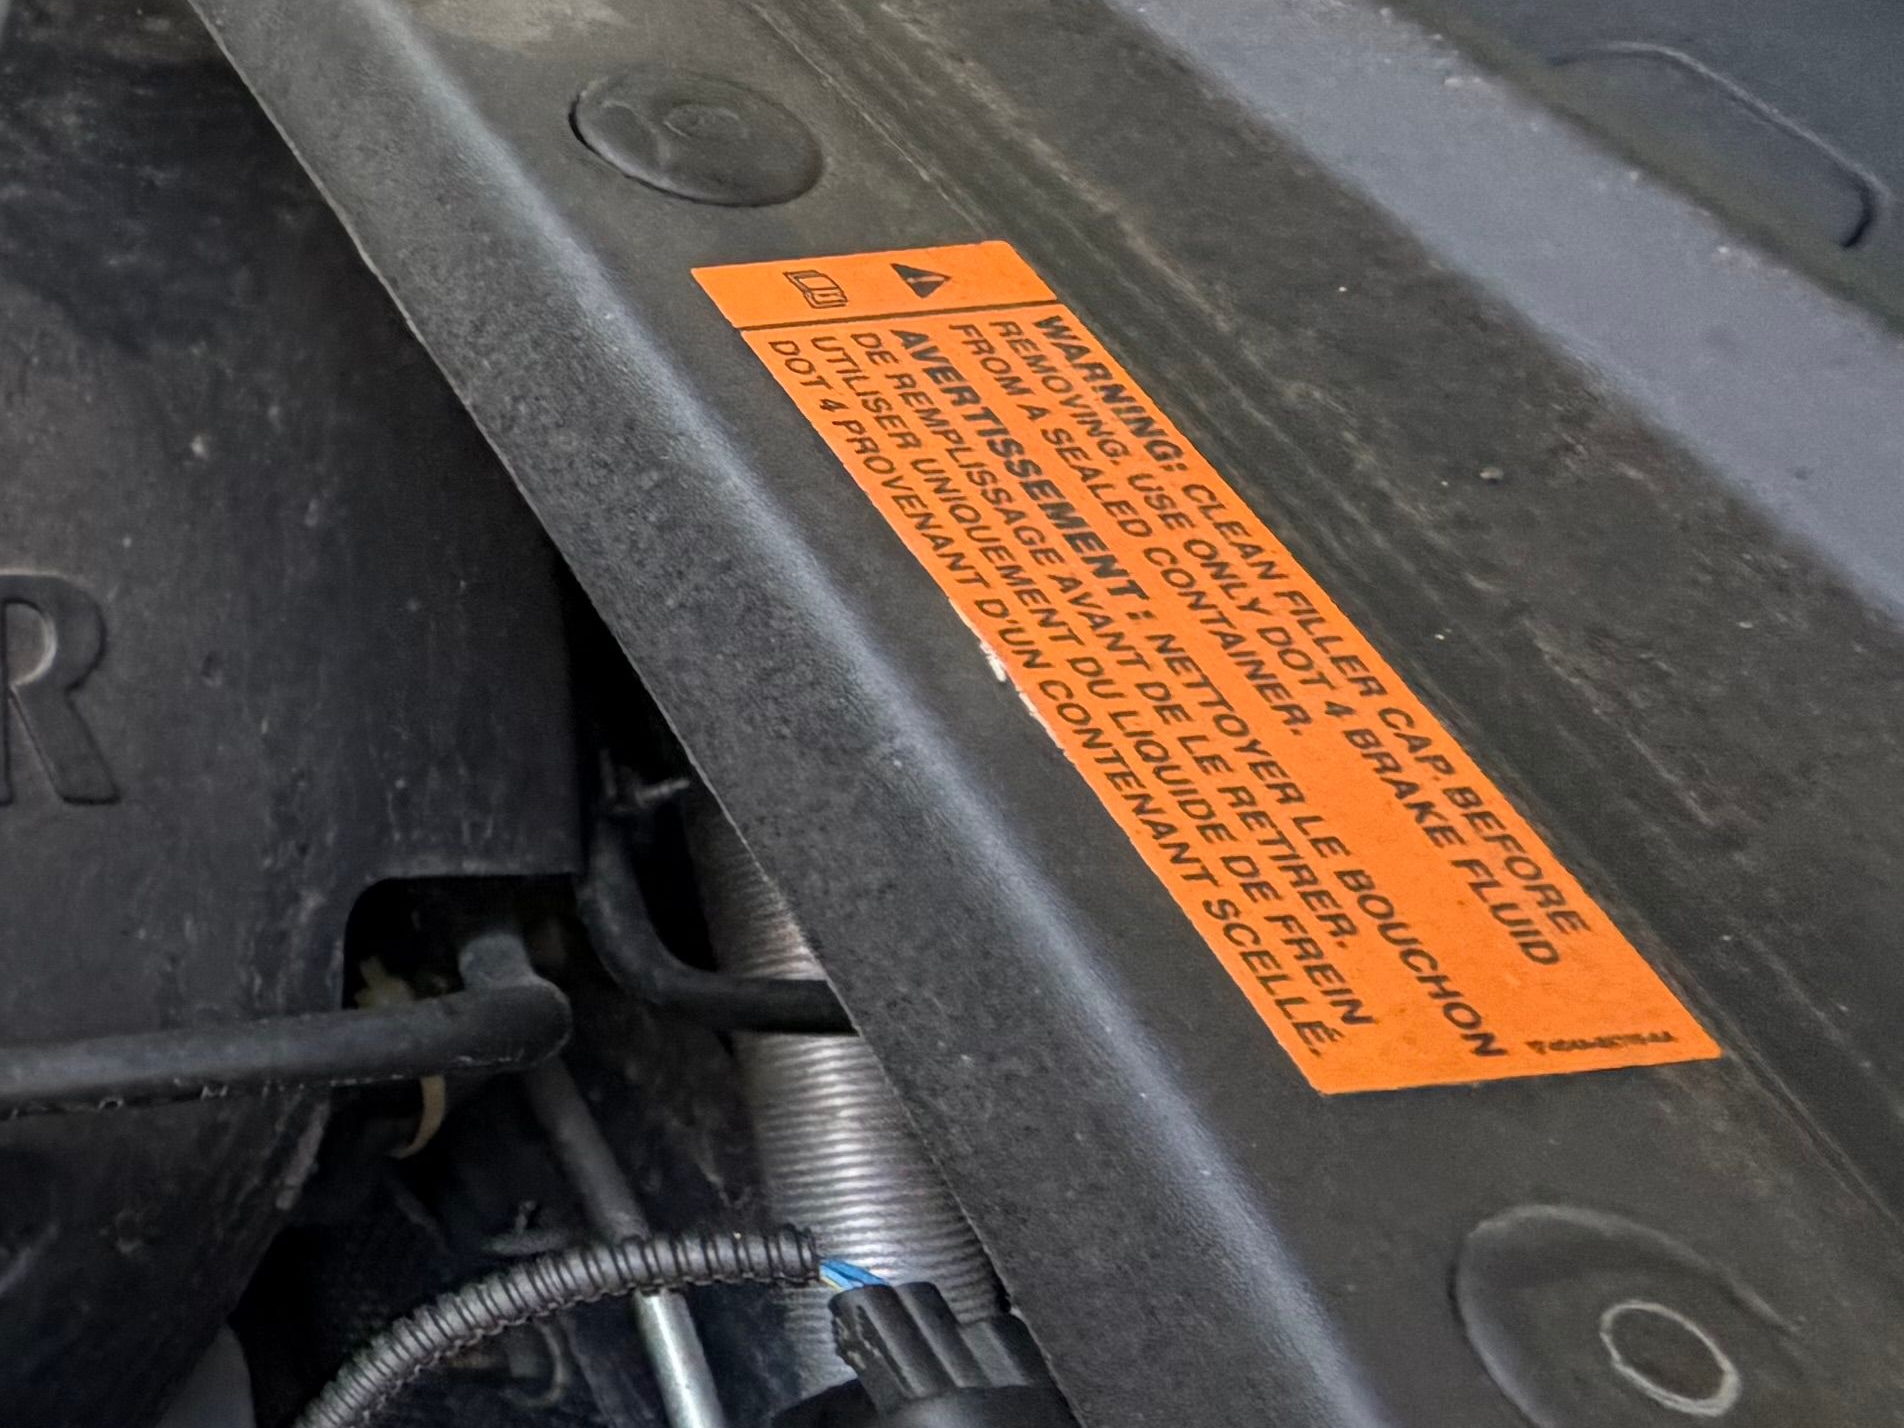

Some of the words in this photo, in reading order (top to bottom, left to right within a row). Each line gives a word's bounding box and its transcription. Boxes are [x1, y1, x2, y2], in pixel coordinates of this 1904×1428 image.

[768, 340, 832, 390] DOT
[819, 398, 849, 413] 4
[831, 419, 990, 588] PROVENANT
[810, 336, 922, 449] UTILISER
[910, 458, 1085, 646] UNIQUEMENT
[1066, 656, 1124, 700] DU
[1108, 710, 1238, 844] LIQUIDE
[1219, 855, 1282, 903] DE
[1263, 914, 1377, 1025] FREIN
[850, 332, 899, 365] DE
[885, 373, 1065, 565] REMPLISSAGE
[1048, 574, 1151, 671] AVANT
[1134, 681, 1192, 725] DE
[1177, 735, 1234, 775] LE
[1217, 785, 1358, 949] RETIRER.
[949, 324, 1034, 396] FROM
[1017, 404, 1051, 421] A
[1041, 428, 1153, 538] SEALED
[1143, 547, 1313, 736] CONTAINER.
[974, 598, 1052, 669] D'UN
[989, 321, 1130, 465] REMOVING.
[1127, 473, 1195, 530] USE
[1183, 538, 1271, 615] ONLY
[1256, 626, 1336, 690] DOT
[1324, 700, 1355, 718] 4
[1343, 728, 1466, 848] BRAKE
[1451, 858, 1561, 966] FLUID
[1033, 315, 1188, 472] WARNING:
[1181, 483, 1289, 580] CLEAN
[1273, 590, 1388, 697] FILLER
[1442, 786, 1590, 933] BEFORE
[1038, 679, 1219, 887] CONTENANT
[1145, 633, 1306, 805] NETTOYER
[1291, 815, 1351, 858] LE
[1333, 869, 1508, 1057] BOUCHON
[1202, 898, 1343, 1057] SCELLÉ.
